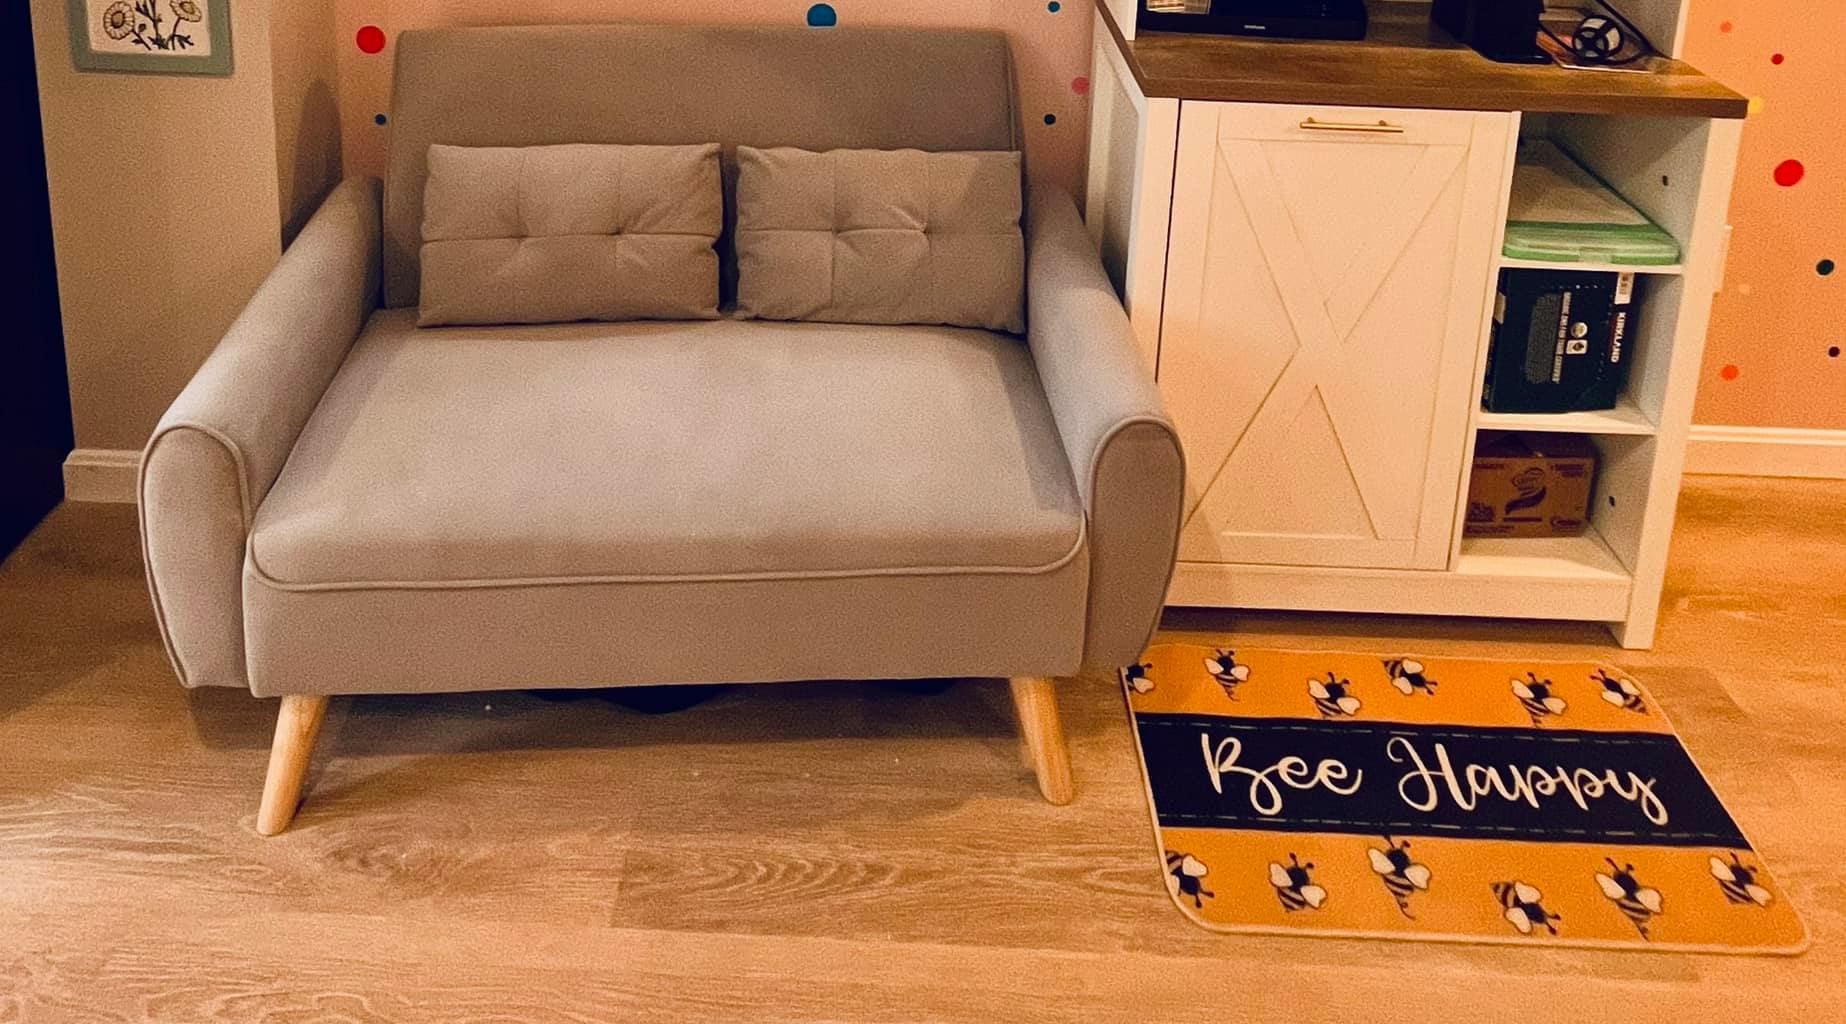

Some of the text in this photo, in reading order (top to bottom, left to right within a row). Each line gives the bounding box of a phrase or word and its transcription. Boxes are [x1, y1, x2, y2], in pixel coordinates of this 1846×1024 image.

[1610, 311, 1628, 364] KIRKLAND
[1200, 732, 1670, 826] Bee Happy
